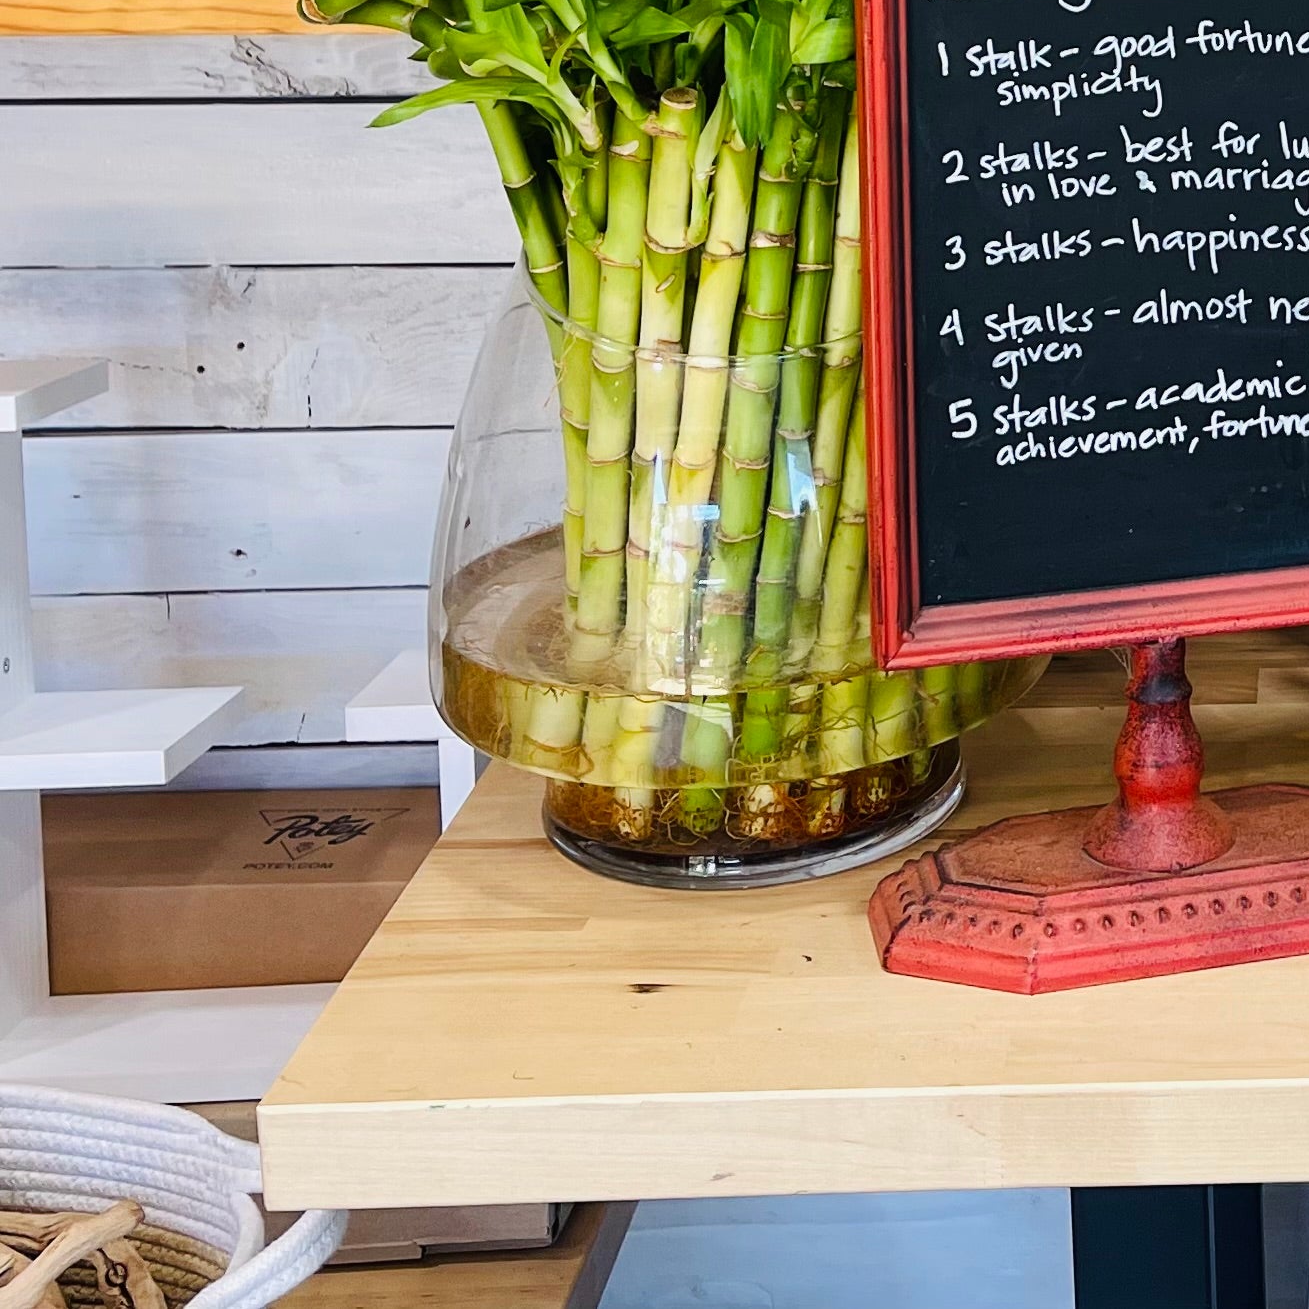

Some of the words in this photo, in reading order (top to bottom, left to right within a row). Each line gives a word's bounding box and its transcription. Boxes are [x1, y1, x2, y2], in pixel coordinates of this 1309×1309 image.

[938, 41, 949, 77] 1
[1094, 25, 1177, 75] good
[996, 65, 1163, 118] simplicity
[942, 149, 969, 184] 2
[979, 141, 1080, 181] stalks
[1119, 124, 1195, 163] best
[1211, 121, 1262, 159] for
[1001, 182, 1036, 208] in
[1048, 173, 1118, 200] love
[1136, 169, 1157, 193] &
[944, 235, 968, 271] 3
[983, 229, 1092, 267] stalks
[938, 307, 966, 347] 4
[984, 301, 1095, 344] stalks
[1132, 288, 1254, 325] almost
[992, 336, 1084, 391] given
[948, 397, 979, 439] 5
[992, 393, 1098, 437] stalks
[1134, 359, 1308, 413] academic
